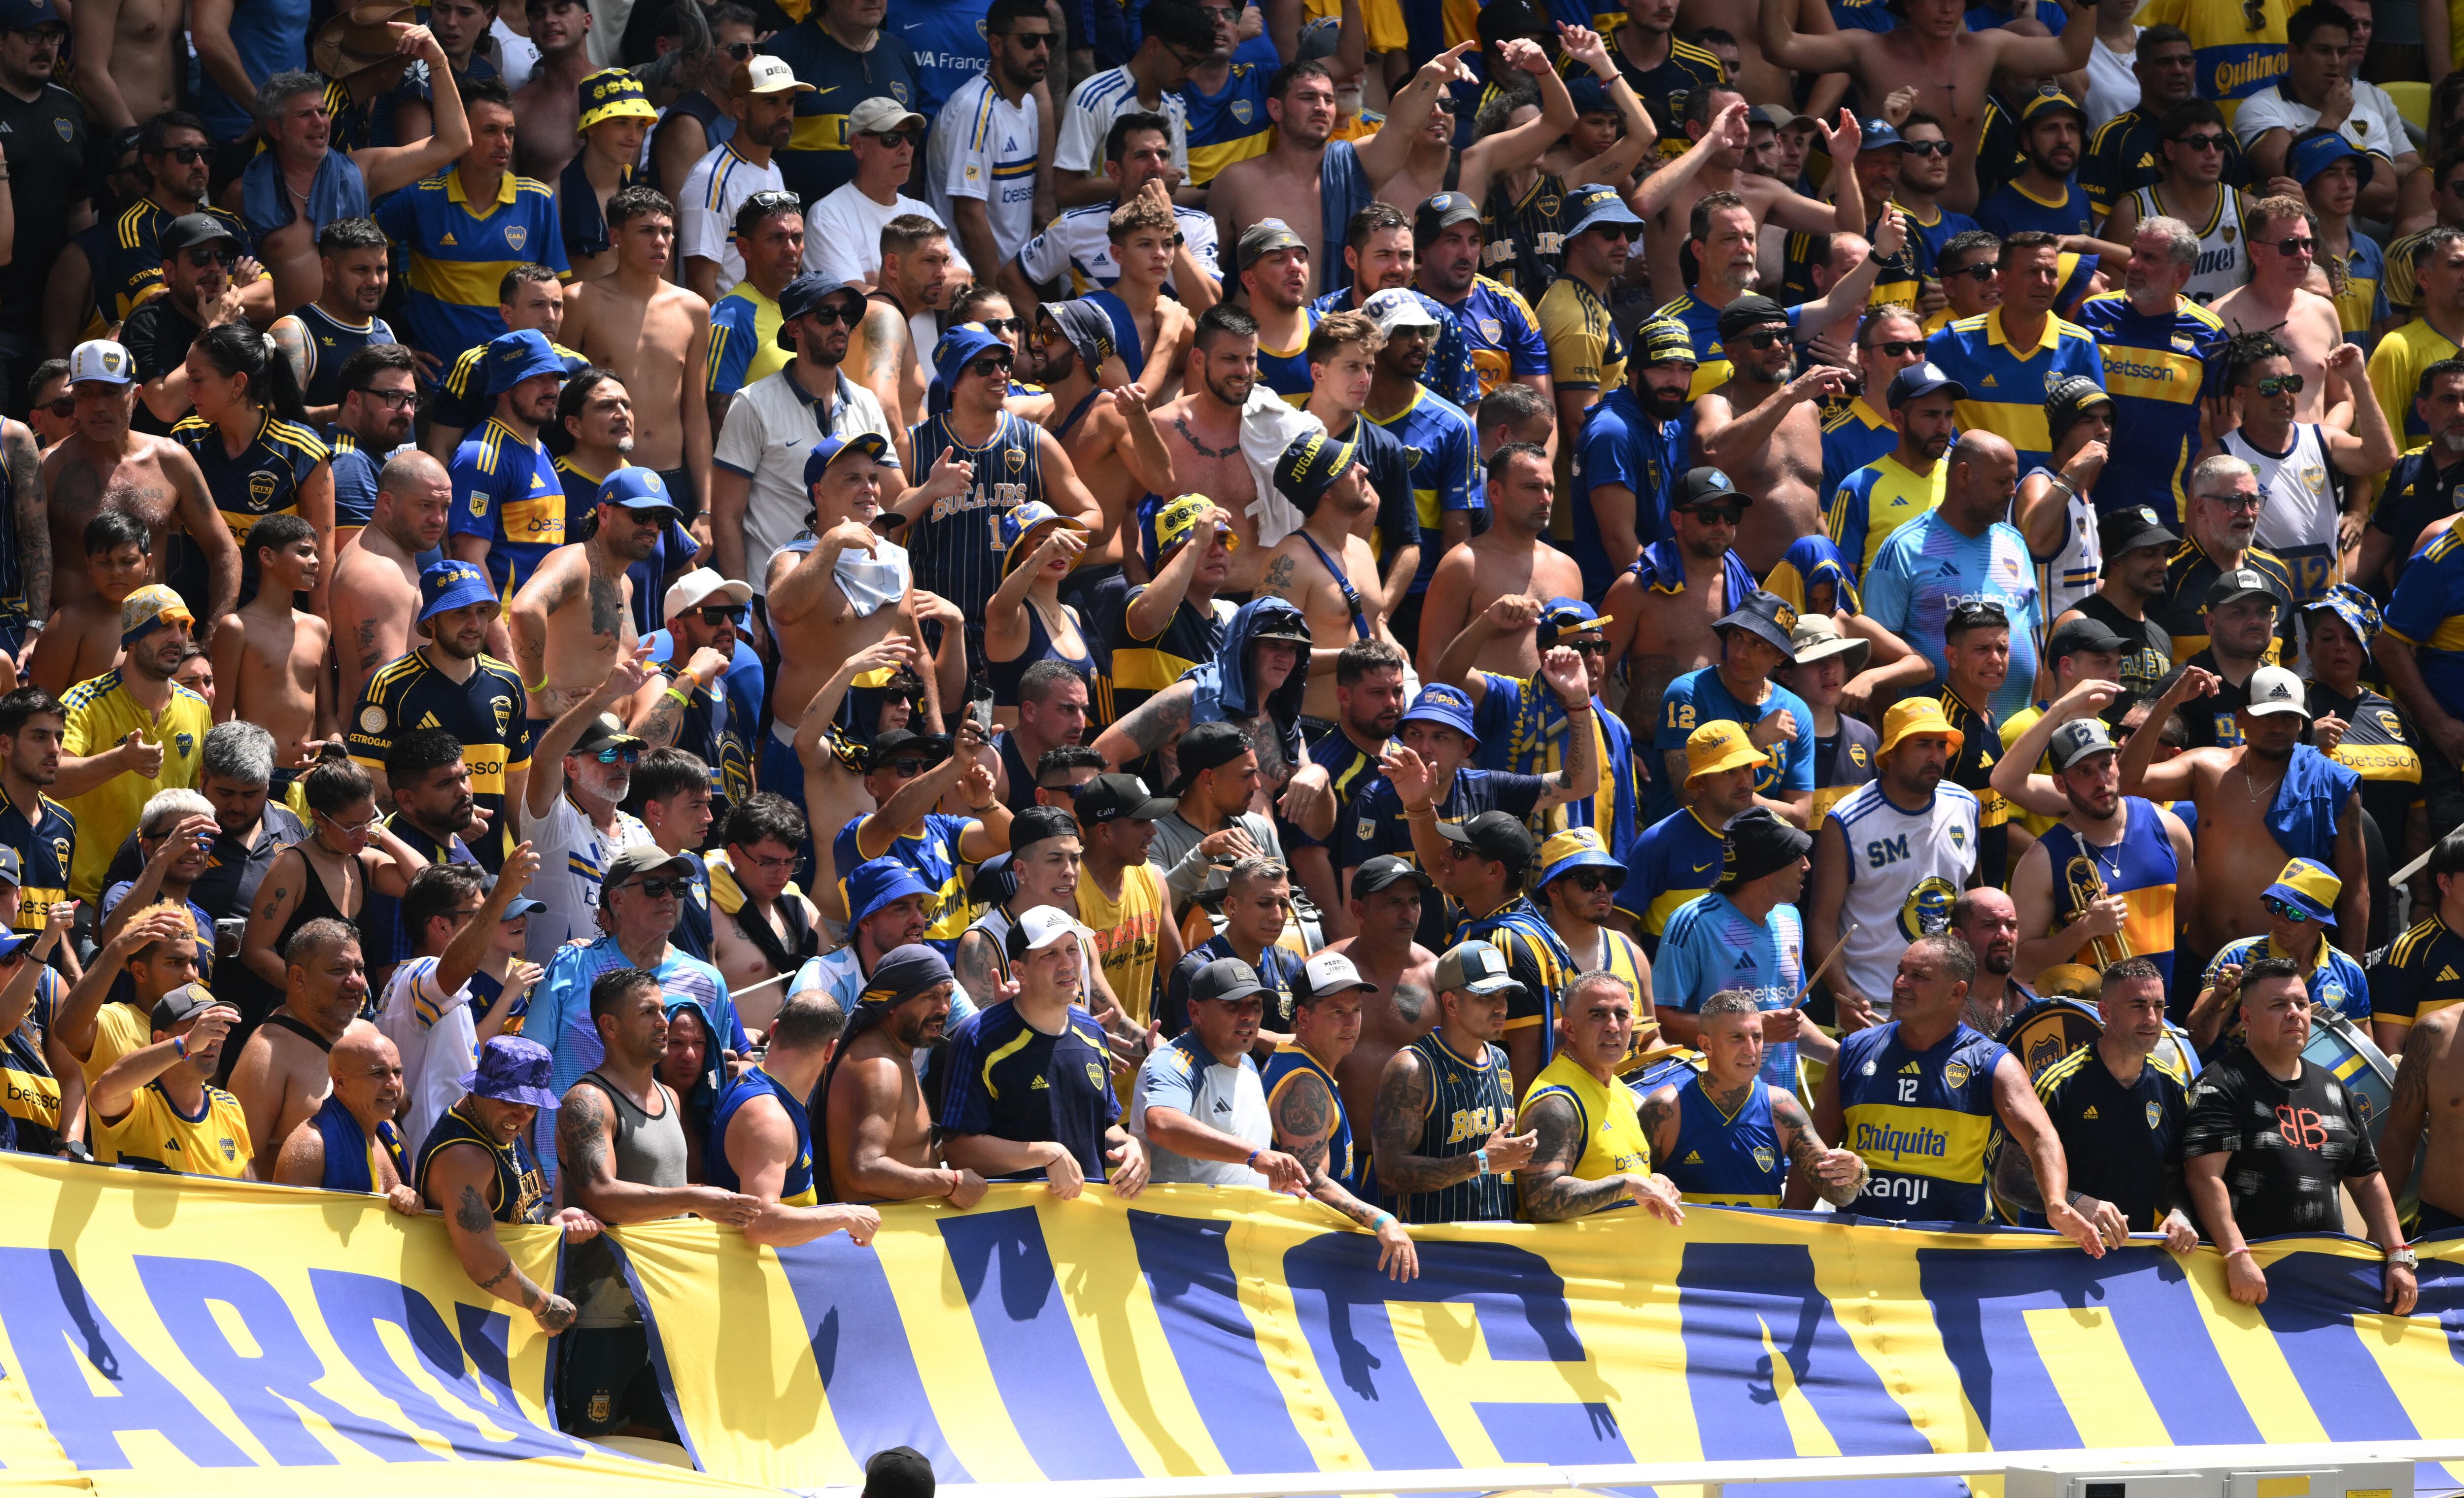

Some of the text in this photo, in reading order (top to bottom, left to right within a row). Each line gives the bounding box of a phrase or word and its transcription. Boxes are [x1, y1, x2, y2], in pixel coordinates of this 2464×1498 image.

[2216, 51, 2289, 95] Quilmes
[1540, 201, 1558, 210] CABJ
[2102, 354, 2174, 383] betsson
[253, 485, 270, 494] CABJ
[932, 483, 1027, 523] BOCA JRS
[2289, 558, 2330, 599] 12
[1437, 695, 1458, 708] pax
[1668, 702, 1696, 729] 12
[349, 733, 393, 749] CETROGAR
[1711, 734, 1732, 749] pax
[2070, 727, 2096, 747] 12
[2343, 753, 2421, 772] betsson
[1096, 807, 1115, 817] Caly
[1867, 833, 1911, 868] SM
[1095, 910, 1157, 953] BANG
[1948, 1070, 1966, 1079] CABJ
[1898, 1078, 1918, 1103] 12
[1446, 1105, 1496, 1144] BOCA
[1858, 1176, 1928, 1206] kanji
